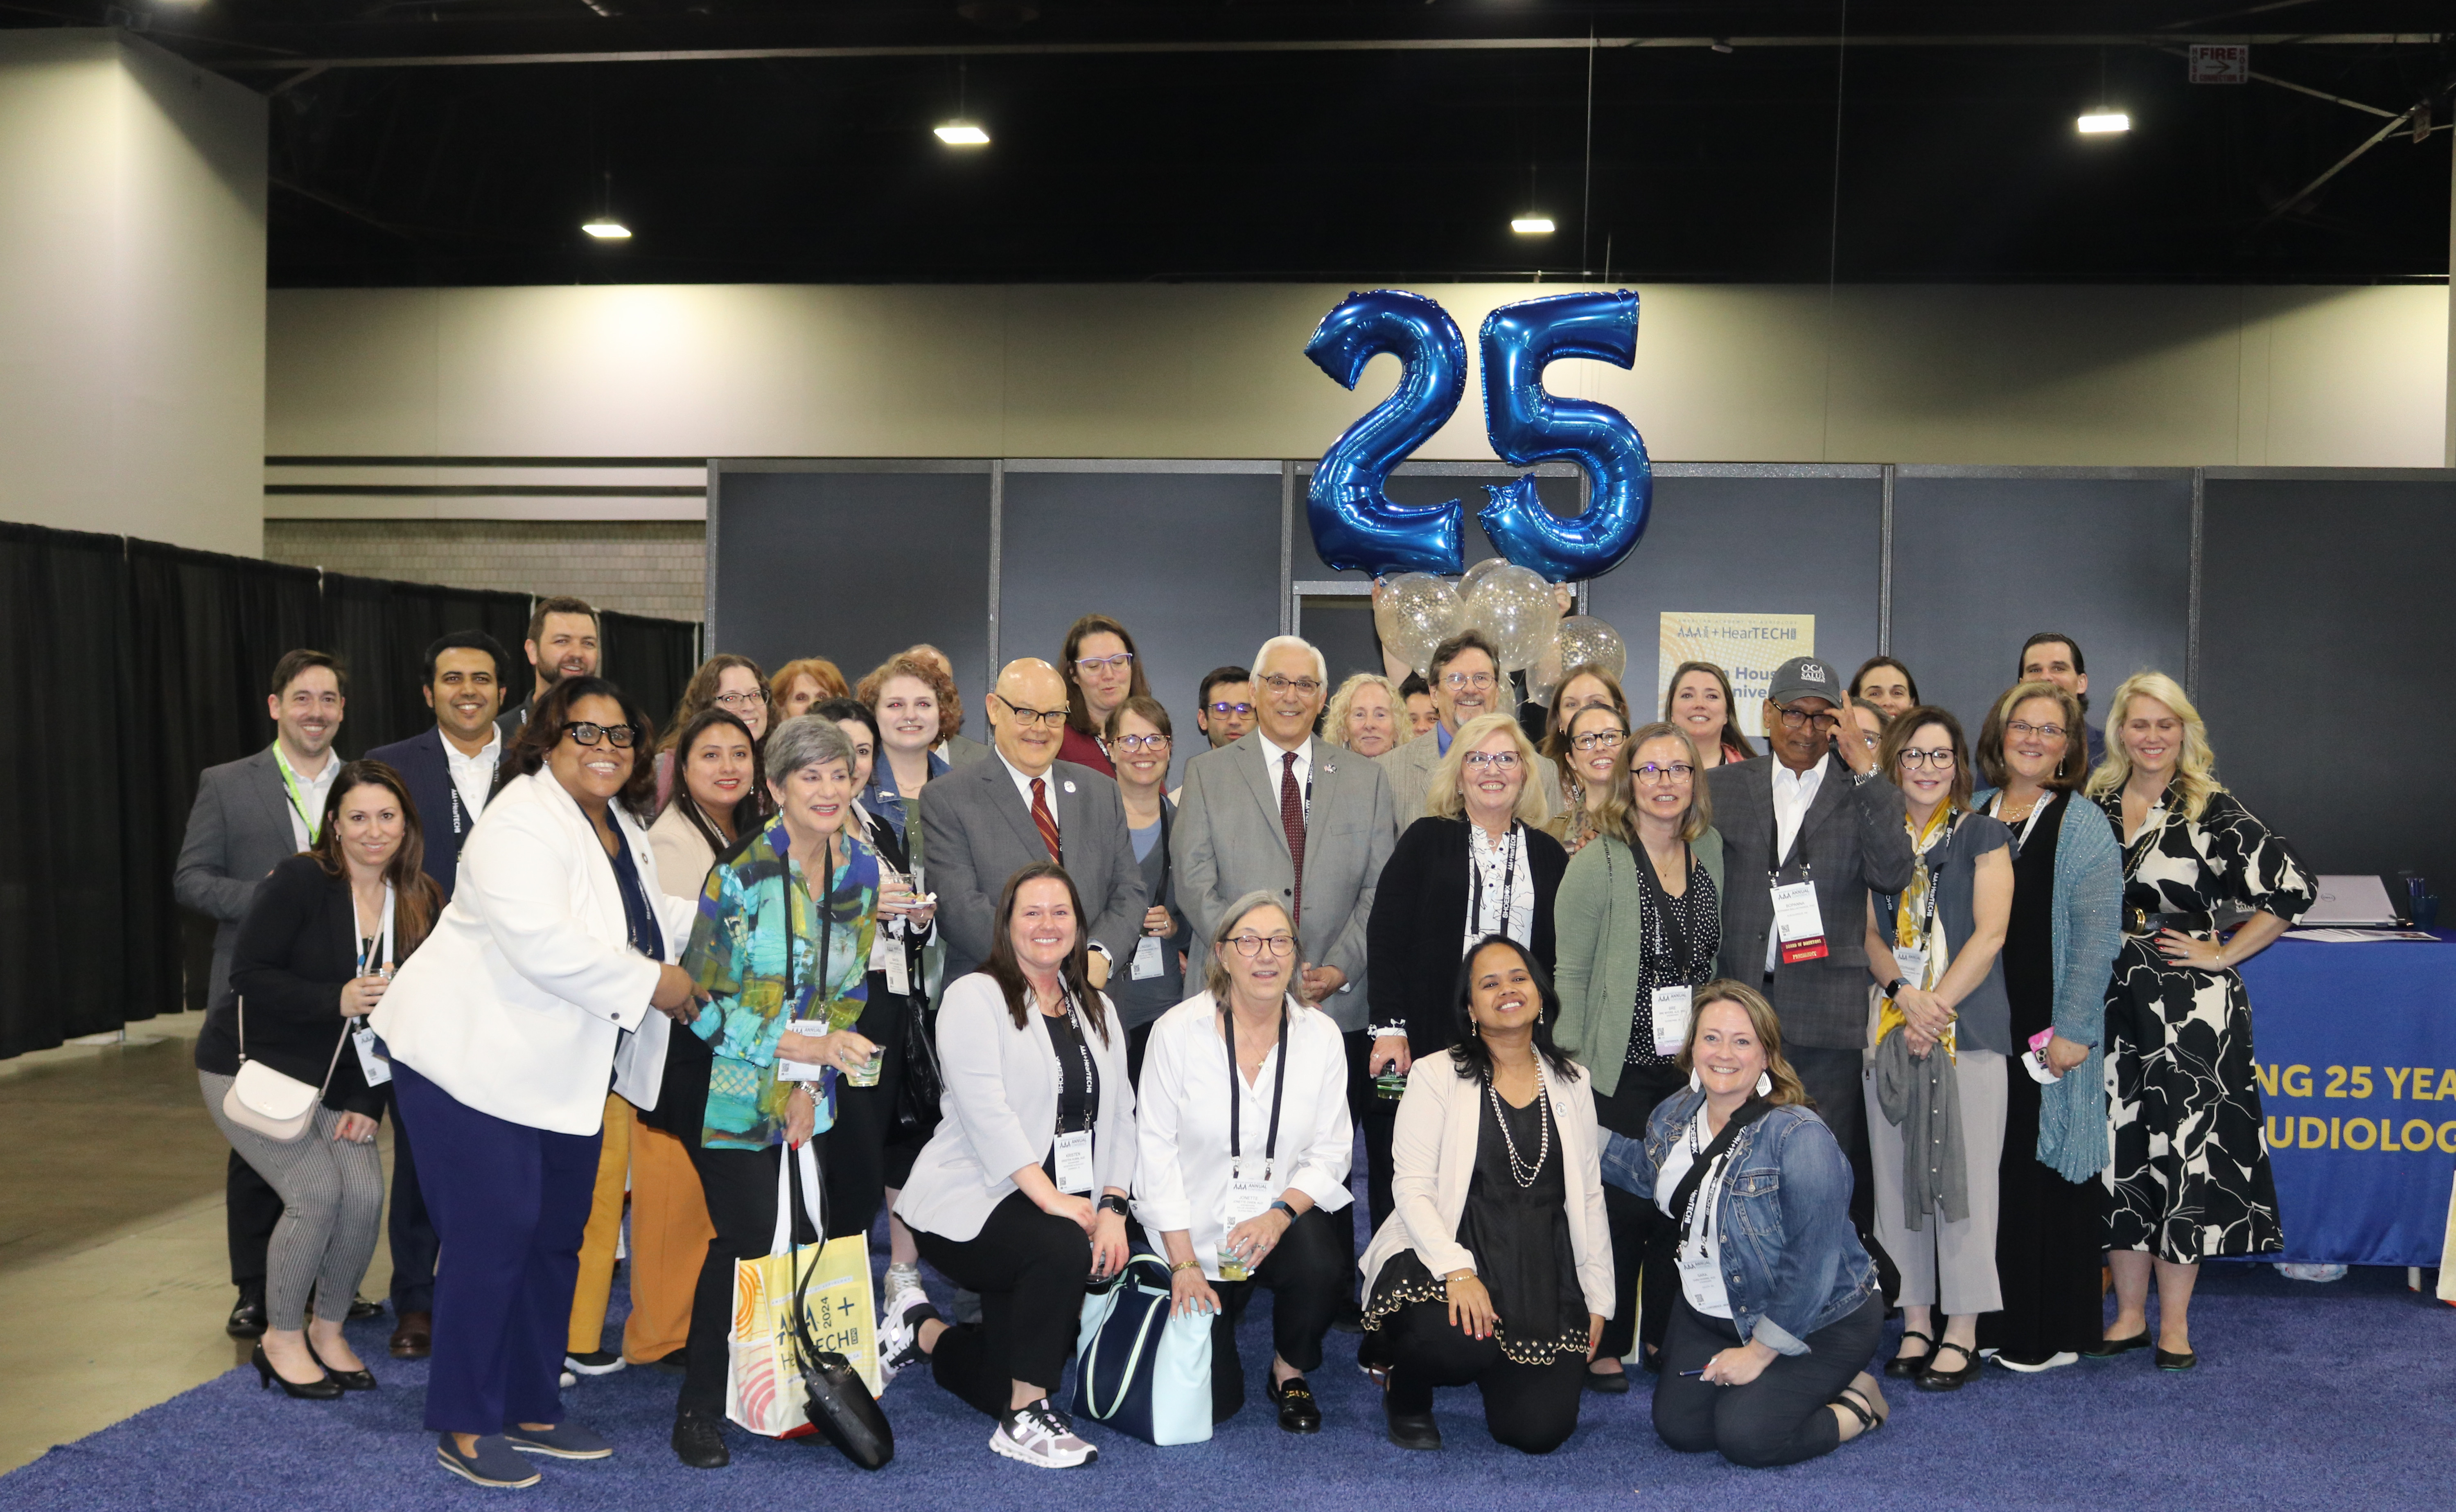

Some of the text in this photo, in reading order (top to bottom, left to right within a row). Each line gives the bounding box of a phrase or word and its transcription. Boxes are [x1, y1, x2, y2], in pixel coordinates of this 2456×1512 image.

[2200, 48, 2237, 60] FIRE
[1303, 288, 1652, 581] 25
[1722, 626, 1790, 640] HearTECH
[1736, 667, 1776, 680] Hous
[1801, 664, 1825, 675] OCA
[1733, 685, 1767, 698] nive
[1094, 736, 1109, 756] OEBOX
[1502, 884, 1511, 919] SHOEBOX
[2255, 1064, 2456, 1101] NG 25 YEA
[2266, 1115, 2456, 1154] UDIOLOG
[1705, 1176, 1718, 1215] SHOEBOX
[821, 1296, 832, 1329] 2024
